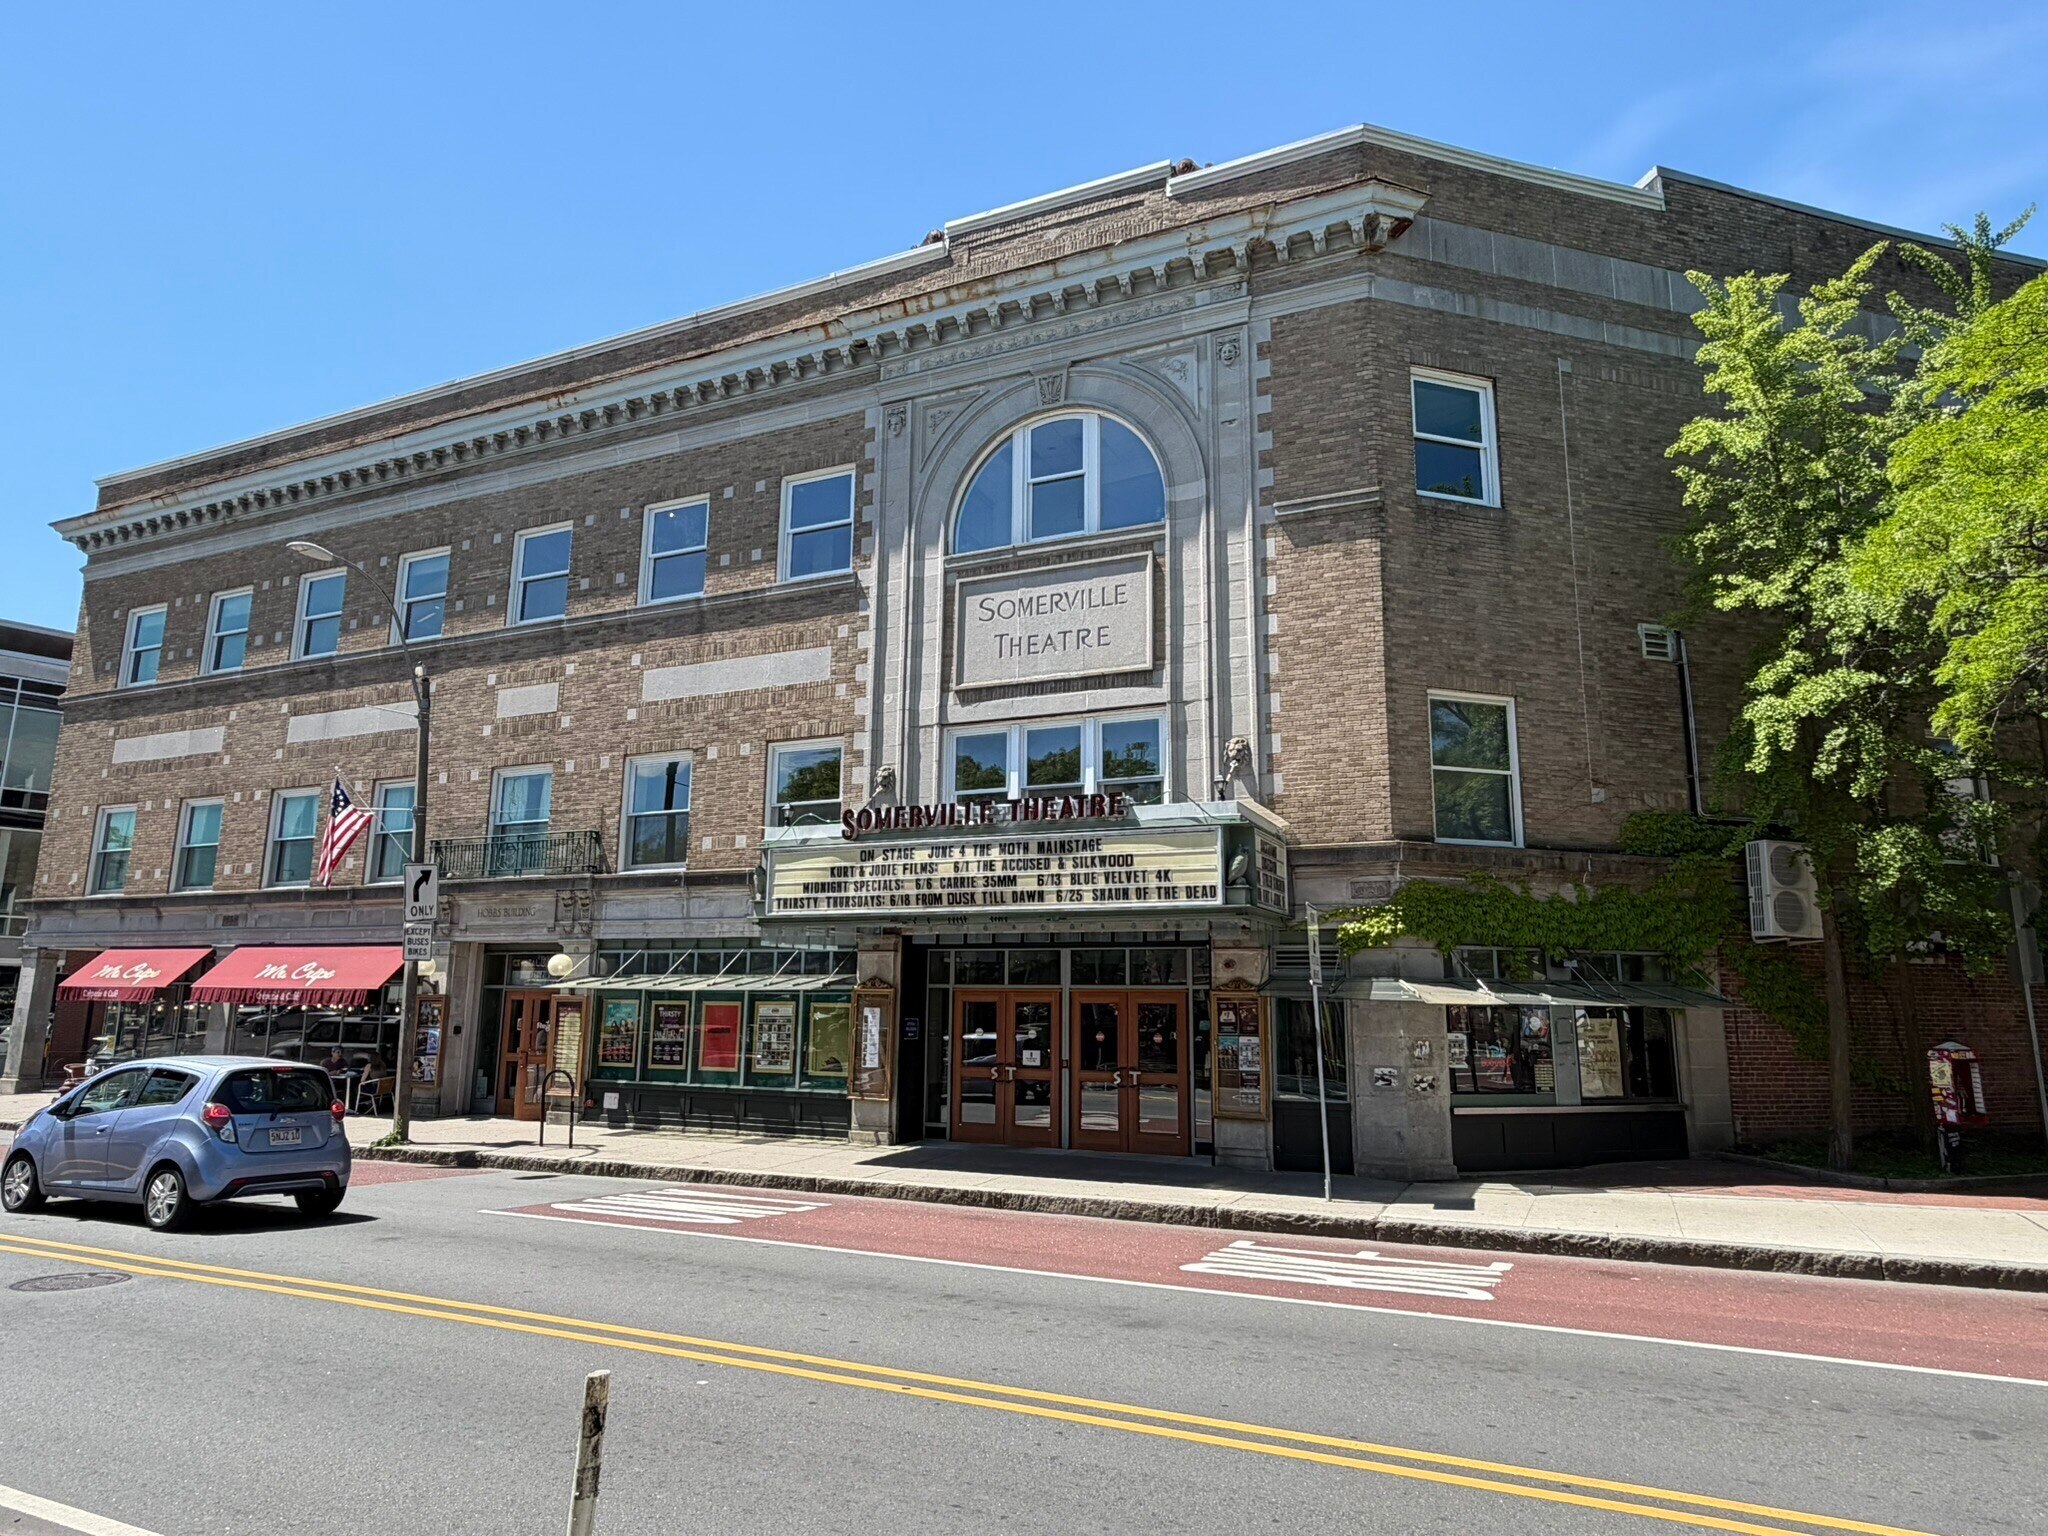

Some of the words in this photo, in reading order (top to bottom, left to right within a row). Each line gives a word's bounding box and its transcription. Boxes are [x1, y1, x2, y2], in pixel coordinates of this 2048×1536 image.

[978, 583, 1129, 622] SOMERVILLE
[994, 625, 1112, 659] THEATRE
[841, 801, 998, 841] SOMERVILLE
[1011, 792, 1130, 822] THEATRE
[860, 850, 874, 862] ON
[882, 848, 915, 861] STAGE
[928, 846, 954, 859] JUNE
[959, 845, 966, 857] 4
[973, 844, 992, 857] THE
[999, 842, 1029, 855] MOTH
[1037, 838, 1102, 855] MAINSTAGE
[830, 866, 855, 878] KURT
[859, 865, 866, 877] &
[869, 864, 897, 876] JODIE
[902, 862, 938, 875] FILMS:
[953, 860, 970, 873] 6/1
[976, 860, 996, 872] THE
[1001, 858, 1051, 871] ACCUSED
[1058, 857, 1065, 870] &
[1072, 854, 1134, 868] SILKWOOD
[803, 881, 848, 894] MIDNIGHT
[853, 879, 904, 893] SPECIALS:
[915, 878, 933, 890] 6/6
[940, 876, 977, 889] CARRIE
[983, 875, 1017, 888] 35MM
[1037, 873, 1061, 886] 6/13
[1070, 871, 1098, 885] BLUE
[1104, 870, 1148, 884] VELVET
[1155, 869, 1172, 883] 4K
[776, 897, 818, 910] THIRSTY
[890, 893, 911, 906] 6/18
[915, 893, 943, 906] FROM
[947, 892, 977, 905] DUSK
[1012, 890, 1044, 903] DAWN
[1056, 889, 1083, 903] 6/25
[1092, 887, 1129, 901] SHAUN
[1136, 886, 1149, 900] OF
[1157, 886, 1179, 900] THE
[1185, 885, 1217, 899] DEAD
[410, 905, 434, 917] ONLY
[503, 906, 536, 917] BUILDING
[406, 927, 431, 936] EXCEPT
[407, 937, 429, 946] BUSES
[407, 947, 428, 956] BIKES
